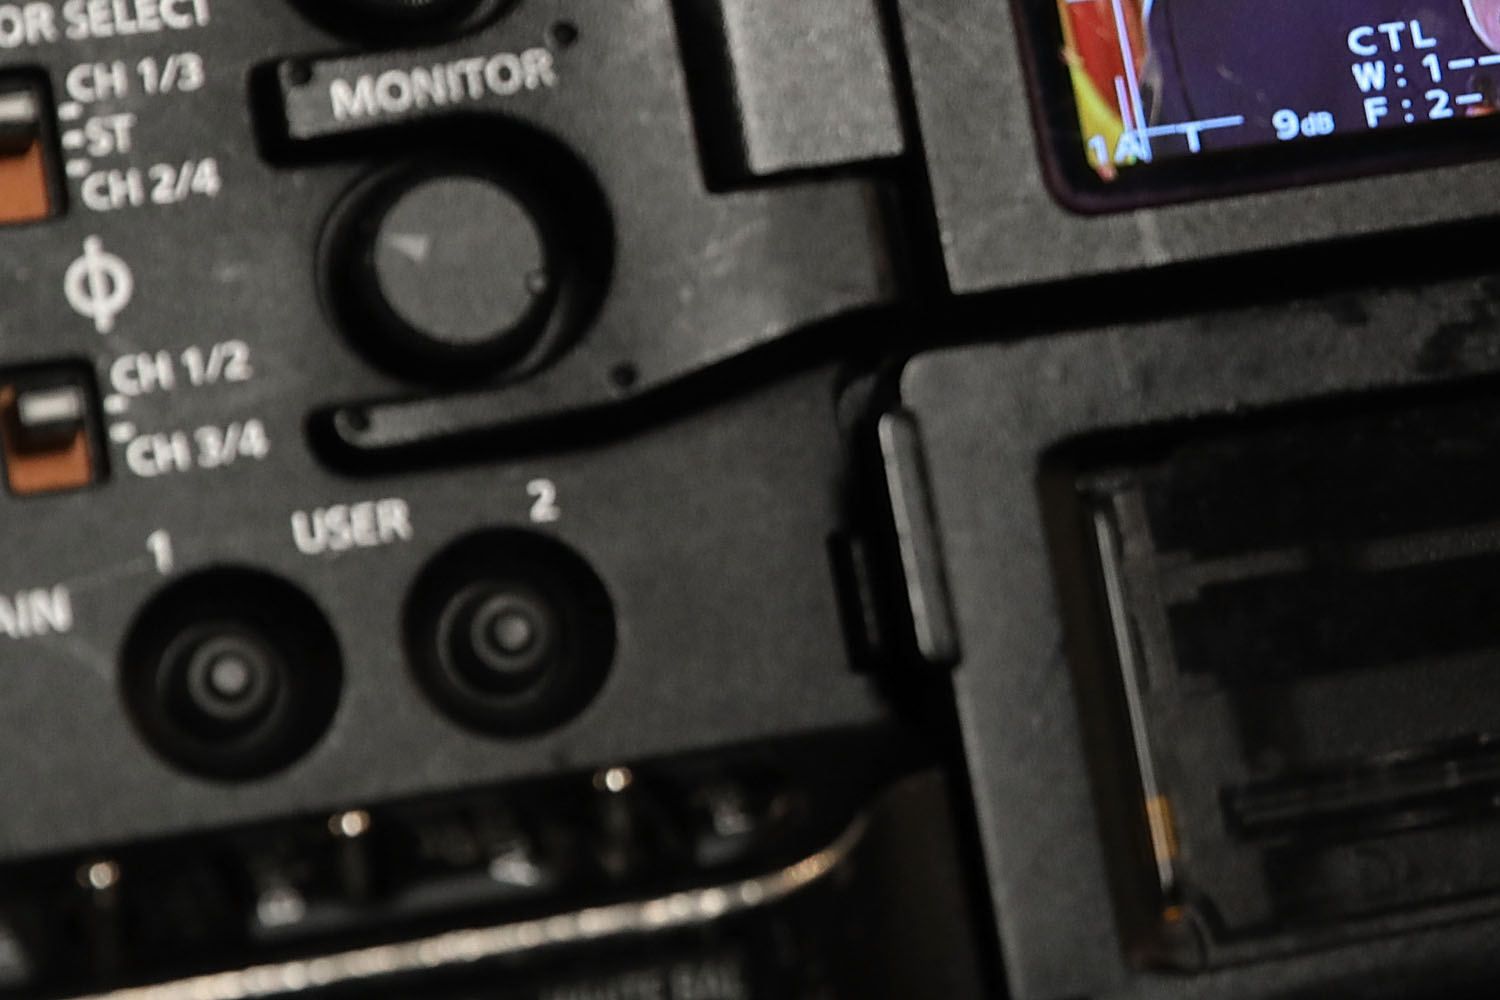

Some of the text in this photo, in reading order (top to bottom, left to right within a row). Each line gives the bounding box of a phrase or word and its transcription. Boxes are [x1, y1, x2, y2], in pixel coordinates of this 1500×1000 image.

[1347, 20, 1437, 56] CTL
[66, 52, 206, 102] CH 1/3
[328, 48, 558, 119] MONITOR
[84, 113, 137, 156] ST
[81, 157, 224, 212] CH 2/4
[110, 340, 253, 396] CH 1/2
[126, 420, 271, 477] CH 3/4
[290, 498, 412, 555] USER
[526, 479, 560, 522] 2
[147, 530, 173, 573] 1
